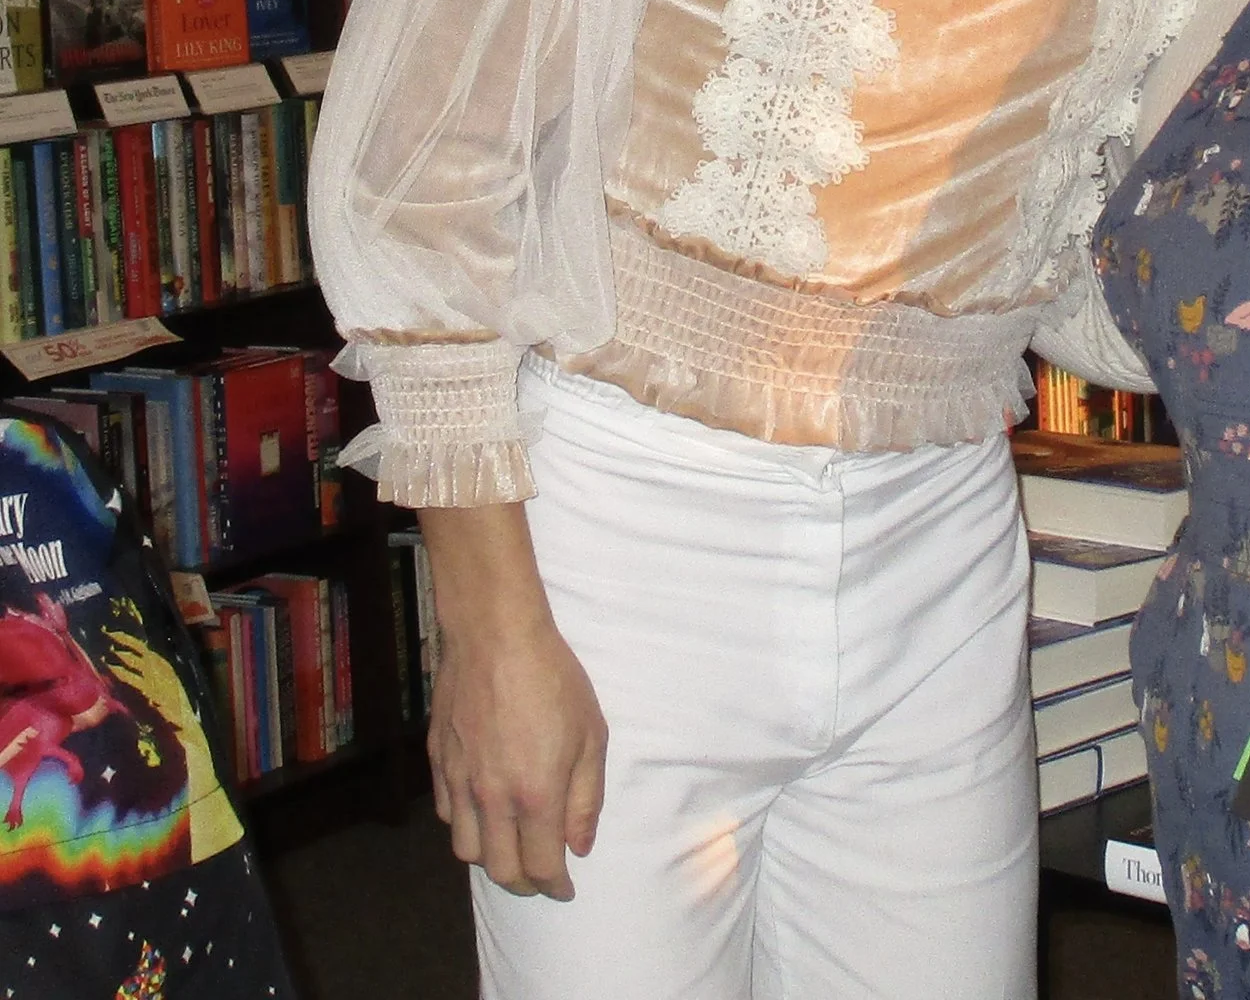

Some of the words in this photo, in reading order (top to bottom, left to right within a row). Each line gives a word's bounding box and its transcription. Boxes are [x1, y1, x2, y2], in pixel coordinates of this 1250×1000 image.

[256, 0, 280, 11] IVEY
[182, 13, 231, 33] Lover
[0, 43, 36, 70] RTS
[176, 40, 205, 58] LILY
[210, 37, 242, 55] KING
[0, 493, 29, 539] ry
